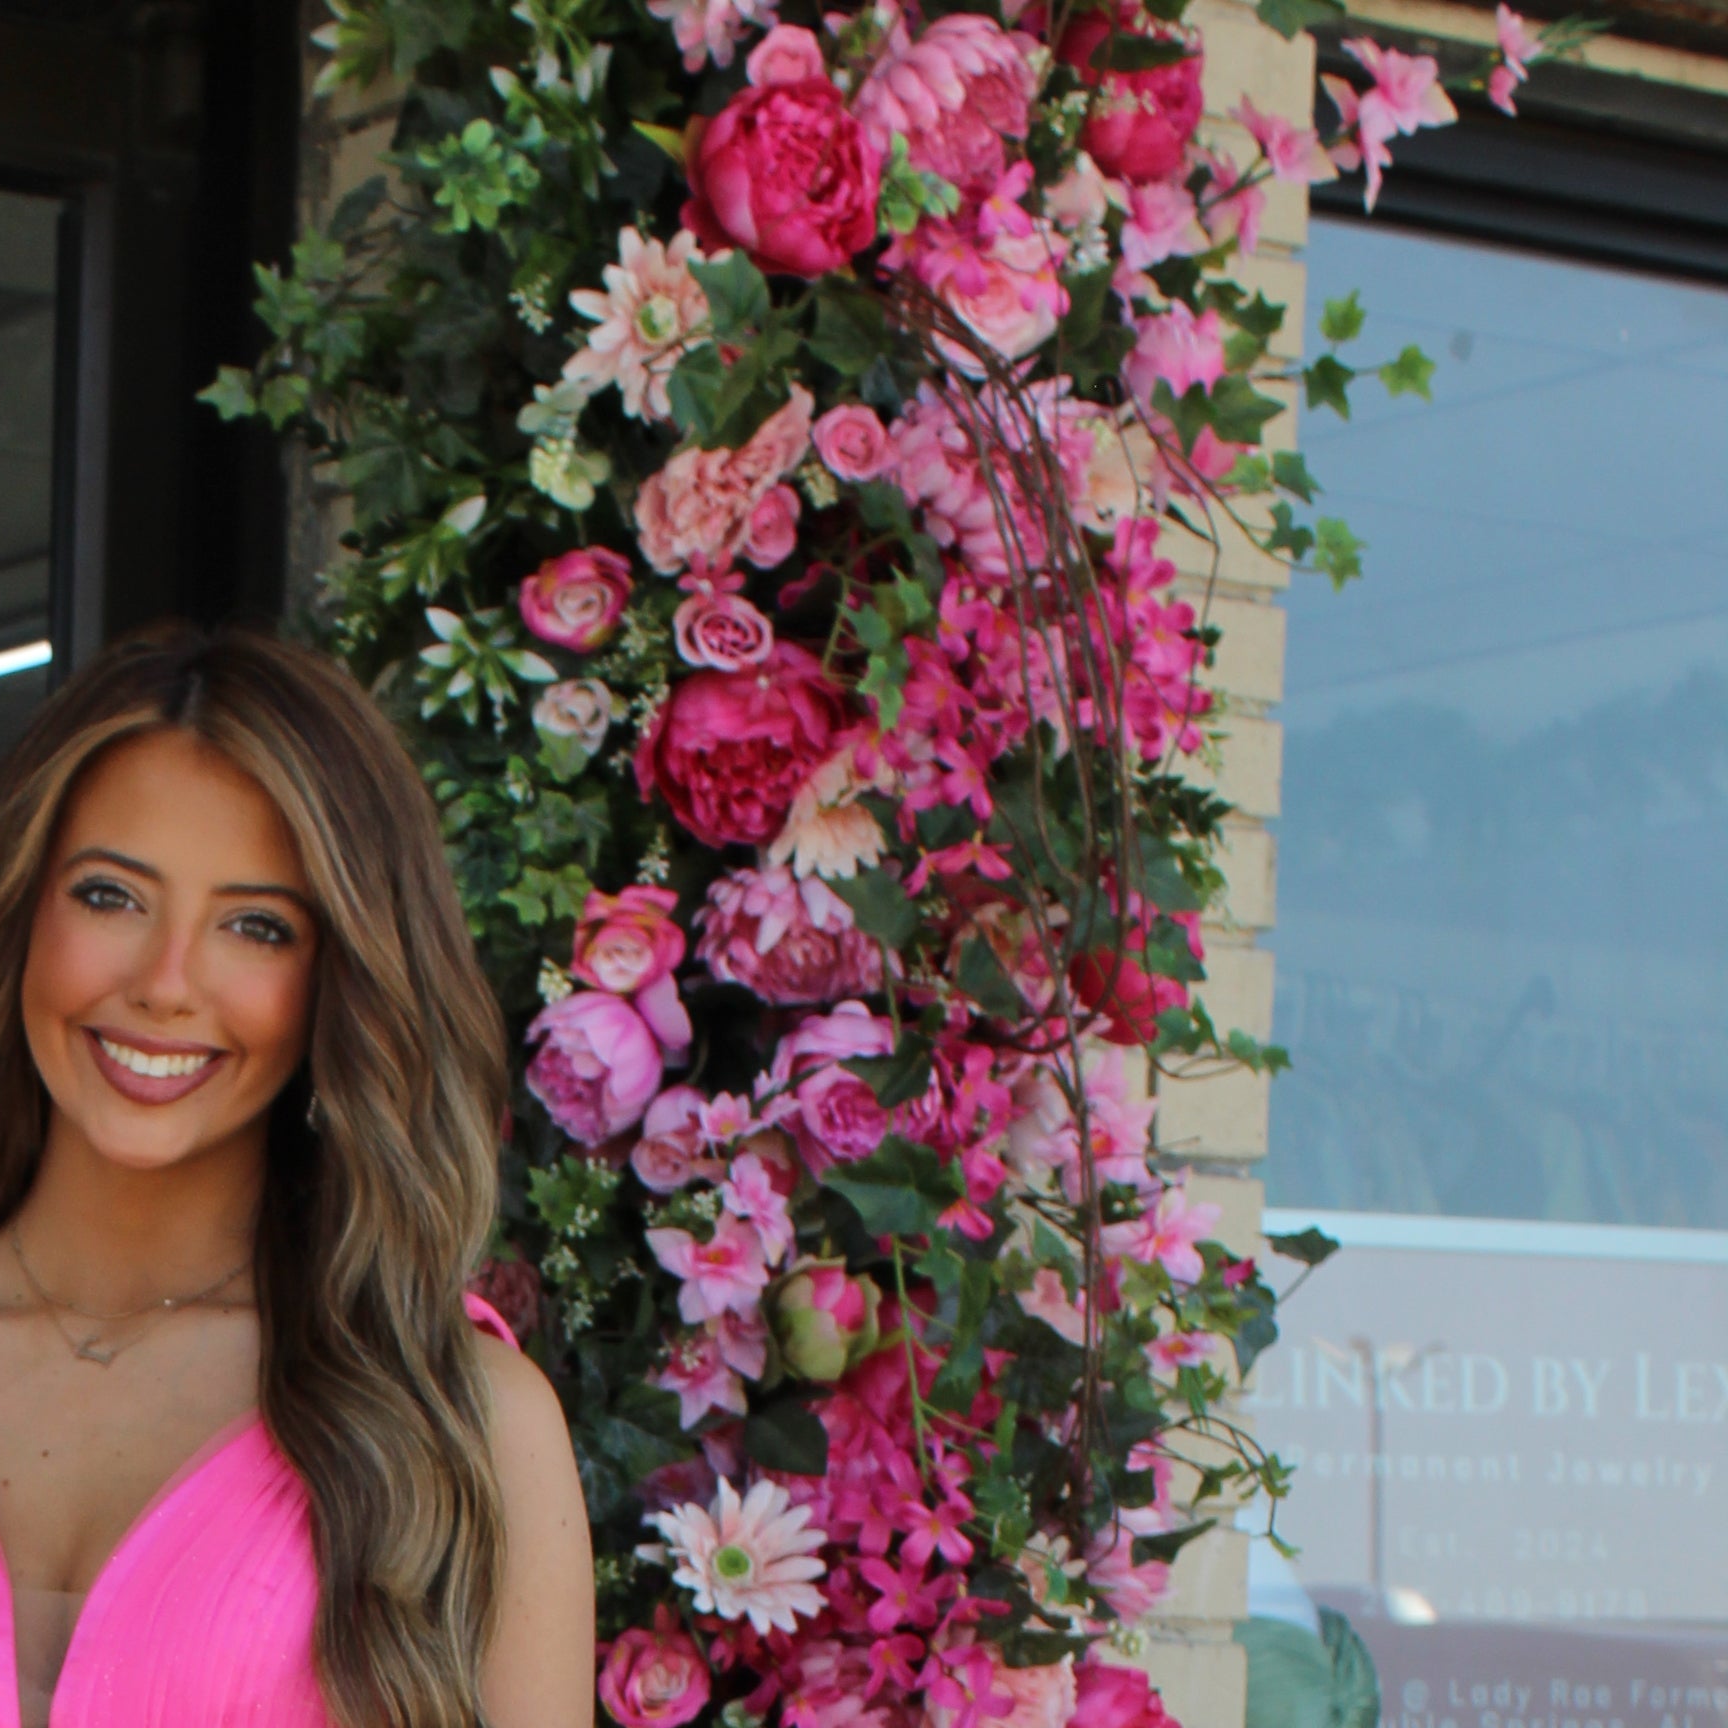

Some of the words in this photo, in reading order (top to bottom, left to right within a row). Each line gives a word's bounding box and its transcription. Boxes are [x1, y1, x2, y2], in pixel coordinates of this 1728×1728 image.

[1531, 1355, 1613, 1419] BY
[1545, 1451, 1711, 1497] Jewelry
[1448, 1677, 1531, 1714] Lady
[1550, 1677, 1612, 1709] Rae
